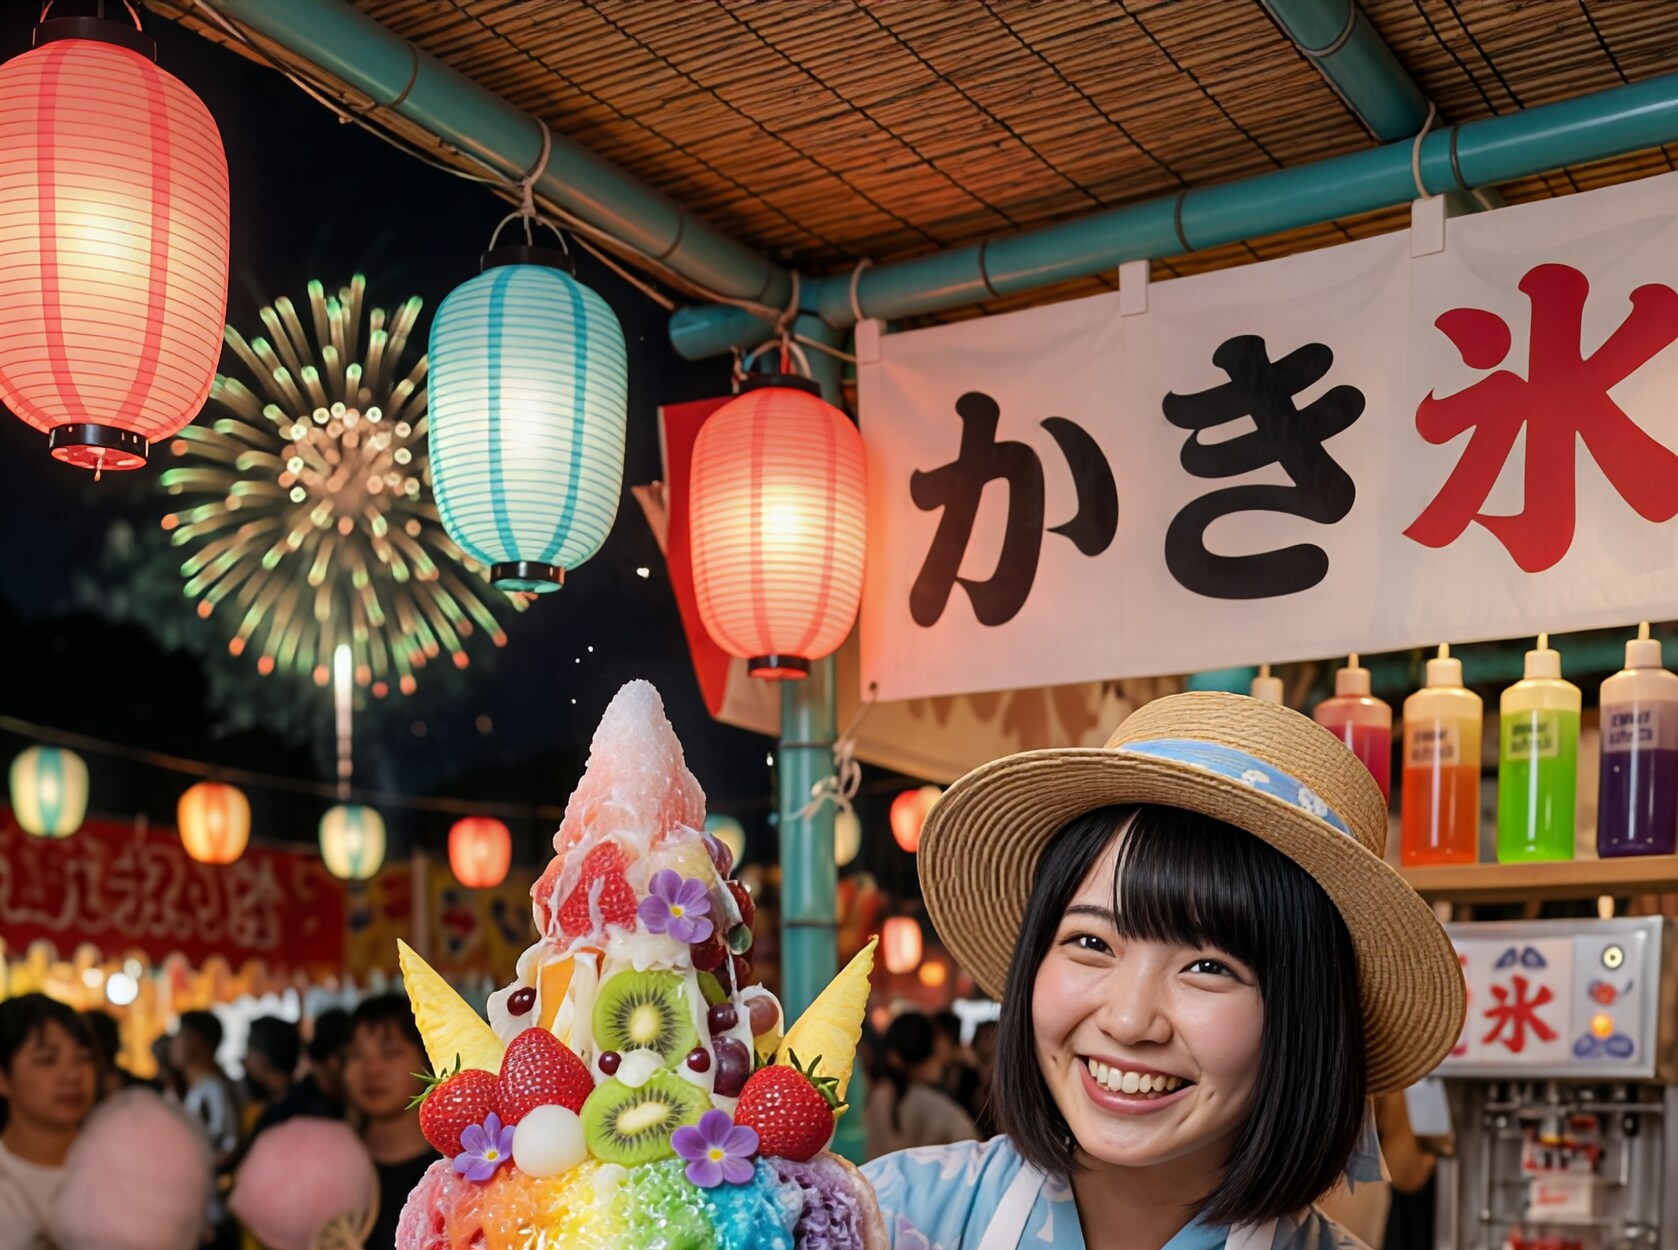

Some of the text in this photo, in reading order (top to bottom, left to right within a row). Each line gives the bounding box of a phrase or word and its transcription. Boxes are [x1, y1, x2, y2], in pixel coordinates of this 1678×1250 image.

[909, 262, 1678, 627] かき氷
[1481, 974, 1560, 1054] 氷
